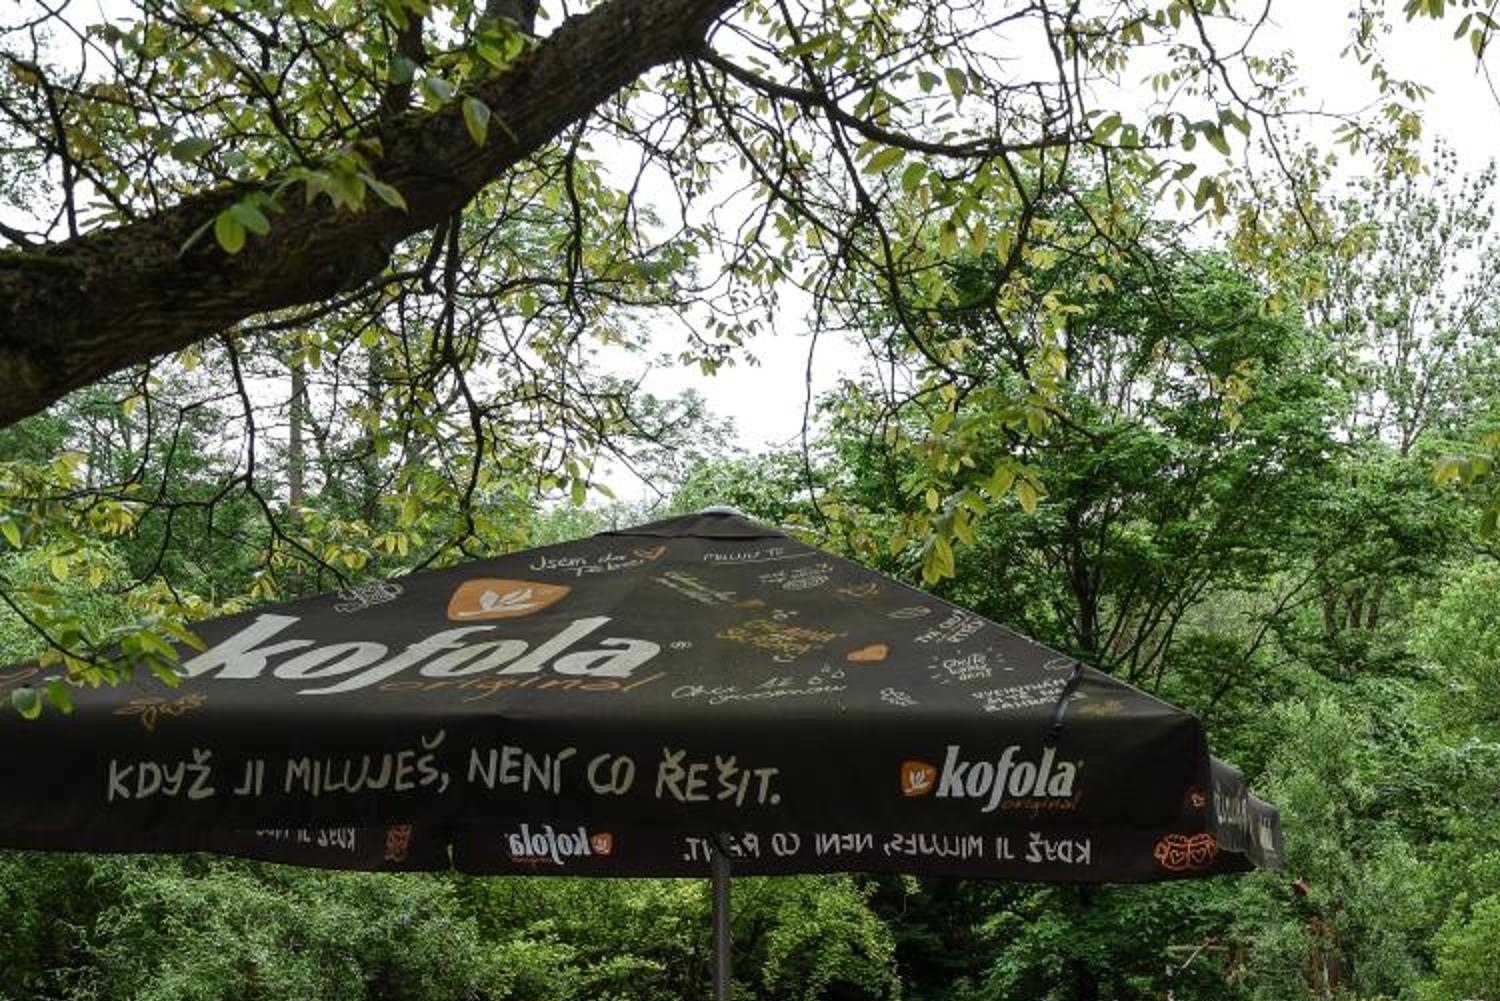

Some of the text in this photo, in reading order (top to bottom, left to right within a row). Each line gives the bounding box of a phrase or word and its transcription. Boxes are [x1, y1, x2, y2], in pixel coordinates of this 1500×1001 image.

[178, 613, 661, 695] kofola
[107, 730, 781, 806] KDYŽ JI MILUJEŠ, NENÍ CO ŘEŠIT.
[936, 746, 1080, 813] kofola
